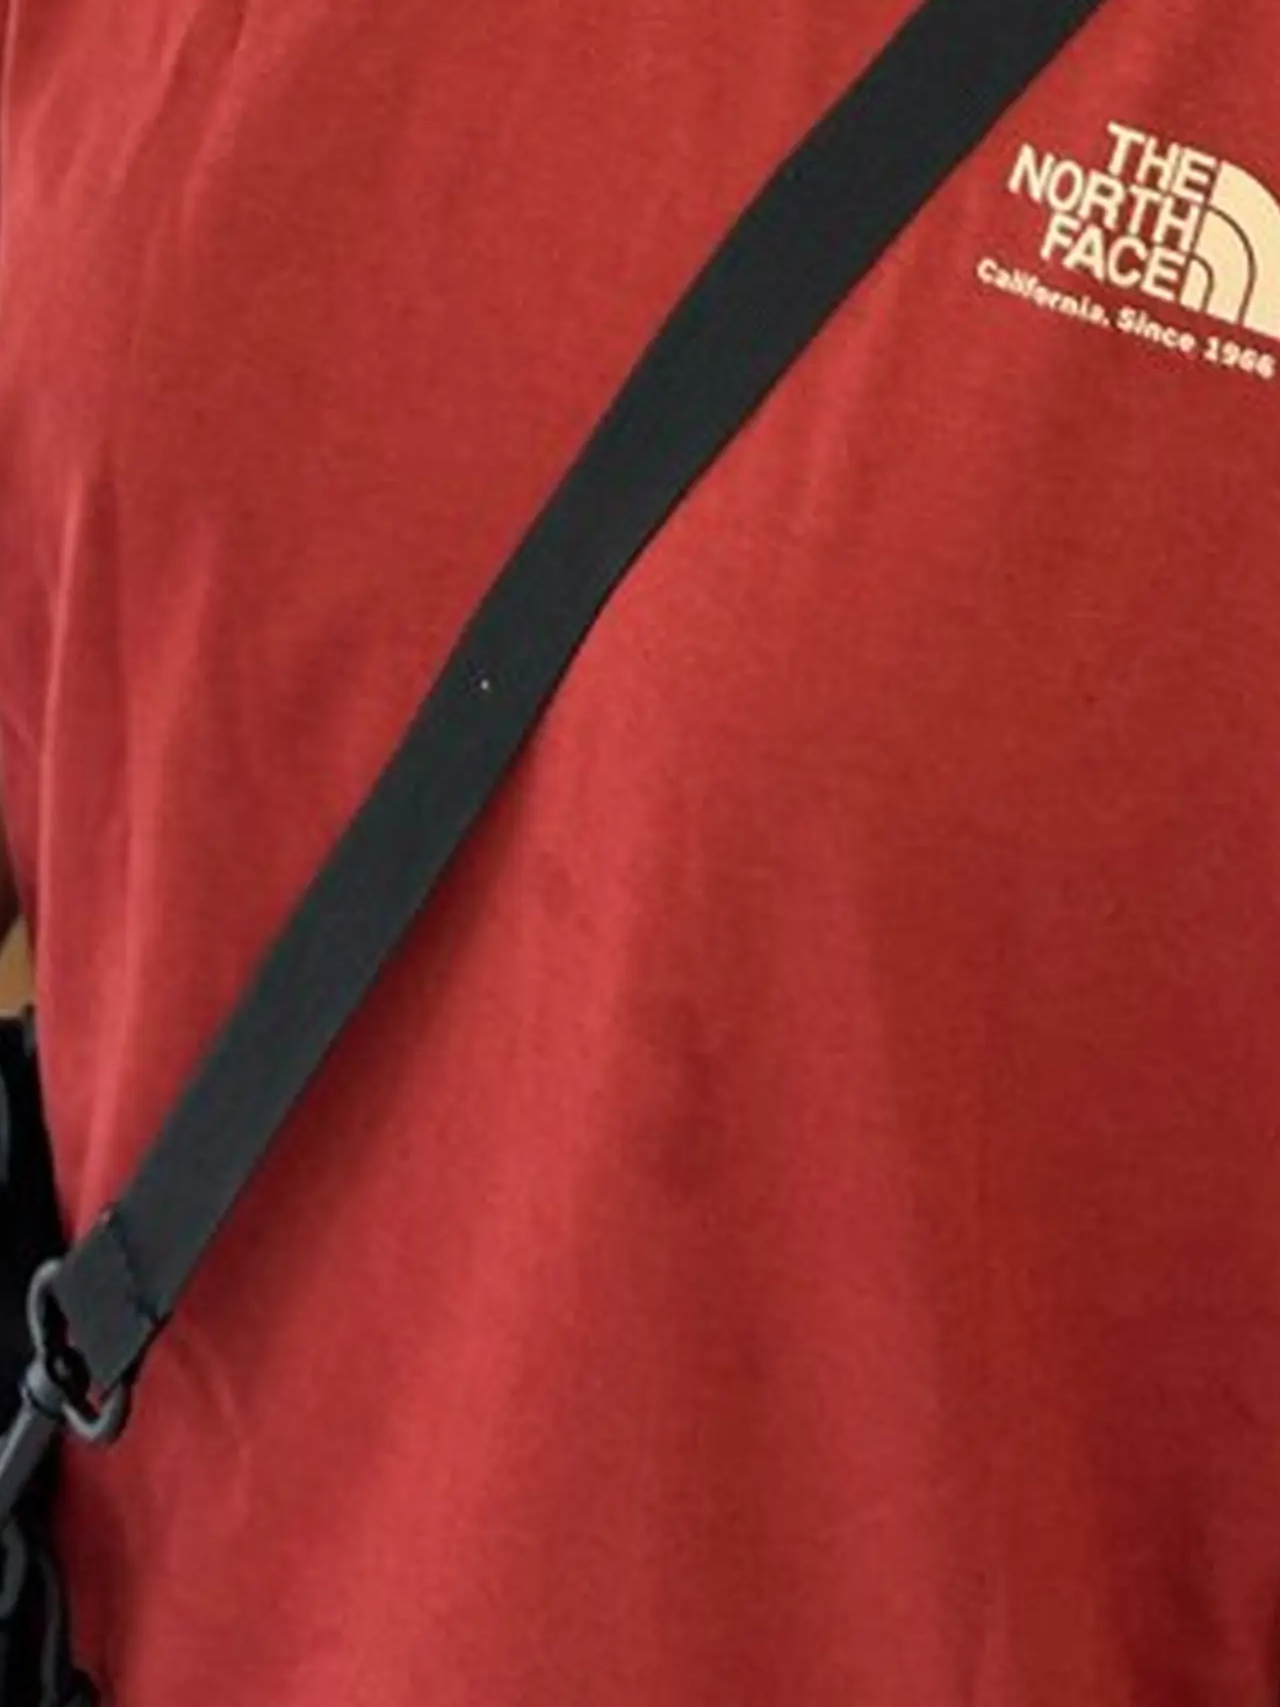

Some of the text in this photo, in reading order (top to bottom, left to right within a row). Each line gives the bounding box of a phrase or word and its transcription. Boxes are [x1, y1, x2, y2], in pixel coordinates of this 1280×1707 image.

[1007, 143, 1202, 255] NORTH
[1107, 120, 1217, 202] THE
[1040, 213, 1187, 301] FACE
[1116, 306, 1197, 352] Since
[1203, 334, 1276, 380] 1966
